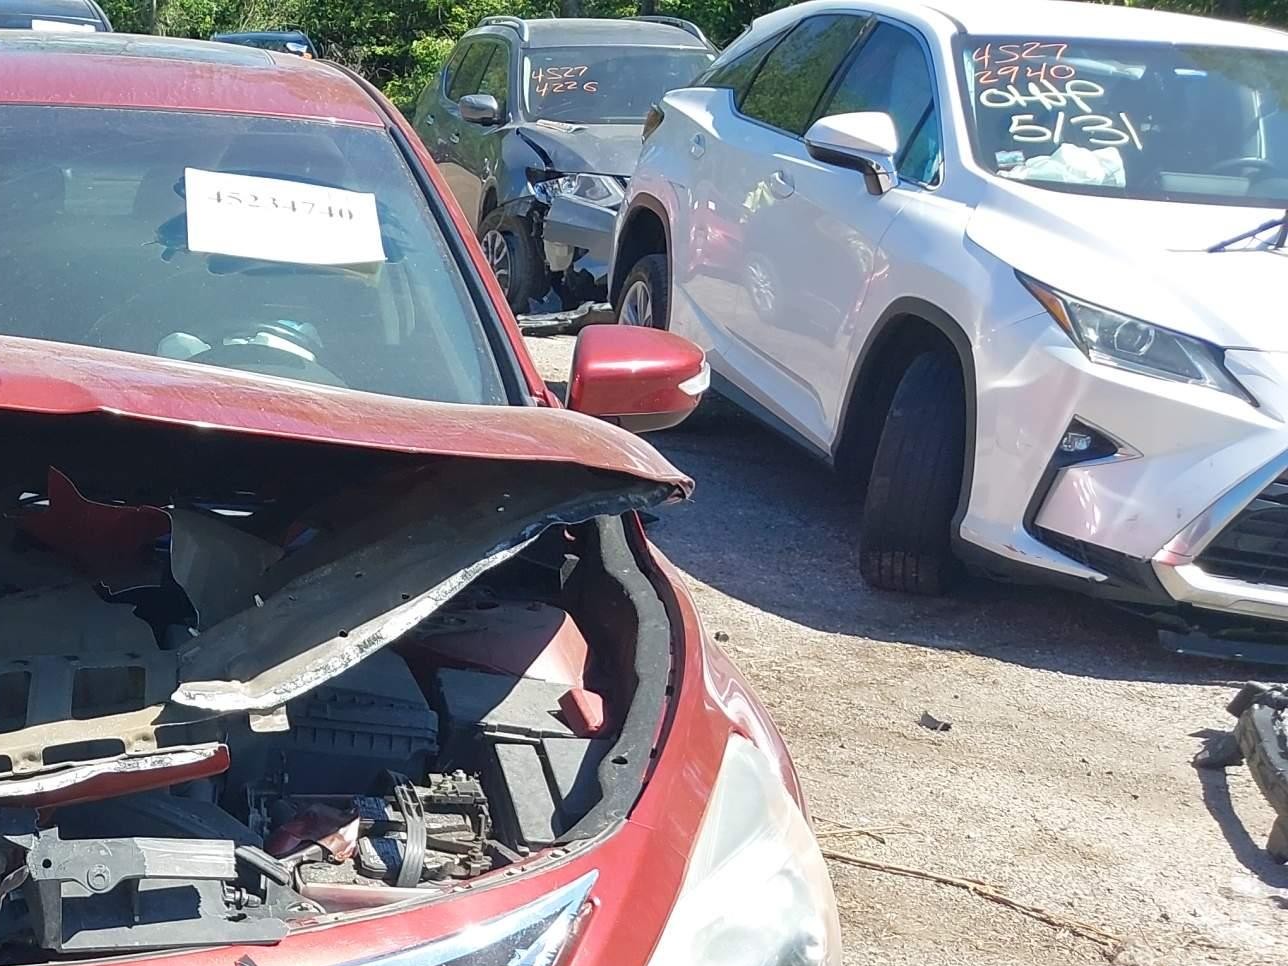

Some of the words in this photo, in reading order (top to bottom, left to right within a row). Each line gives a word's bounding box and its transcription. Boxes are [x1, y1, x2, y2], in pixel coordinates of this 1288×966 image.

[972, 42, 1067, 69] 4527
[531, 66, 588, 82] 4527
[974, 63, 1075, 84] 2940
[535, 81, 599, 97] 4226
[1009, 112, 1143, 150] 5/31
[208, 189, 355, 221] 45234740
